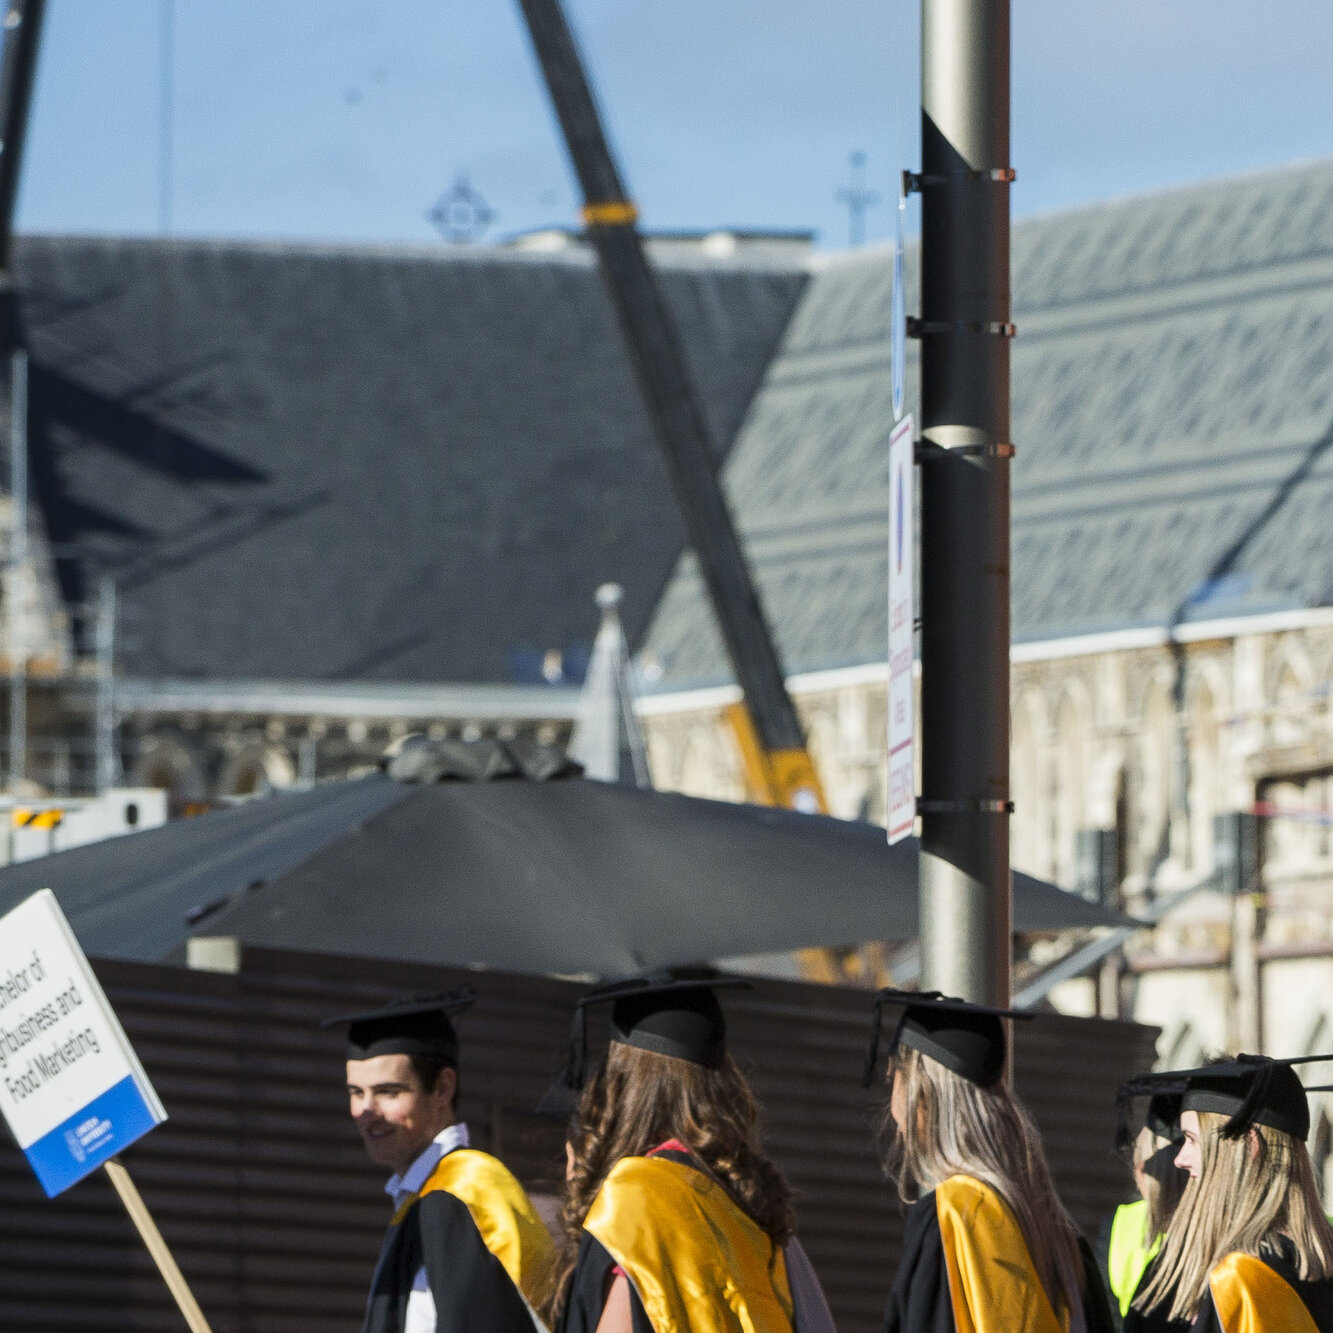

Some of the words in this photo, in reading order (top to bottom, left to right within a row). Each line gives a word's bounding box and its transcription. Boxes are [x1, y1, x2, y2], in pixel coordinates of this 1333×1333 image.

[30, 949, 47, 982] of
[55, 976, 83, 1016] and
[4, 1059, 41, 1105] Food
[33, 1027, 101, 1082] Marketing
